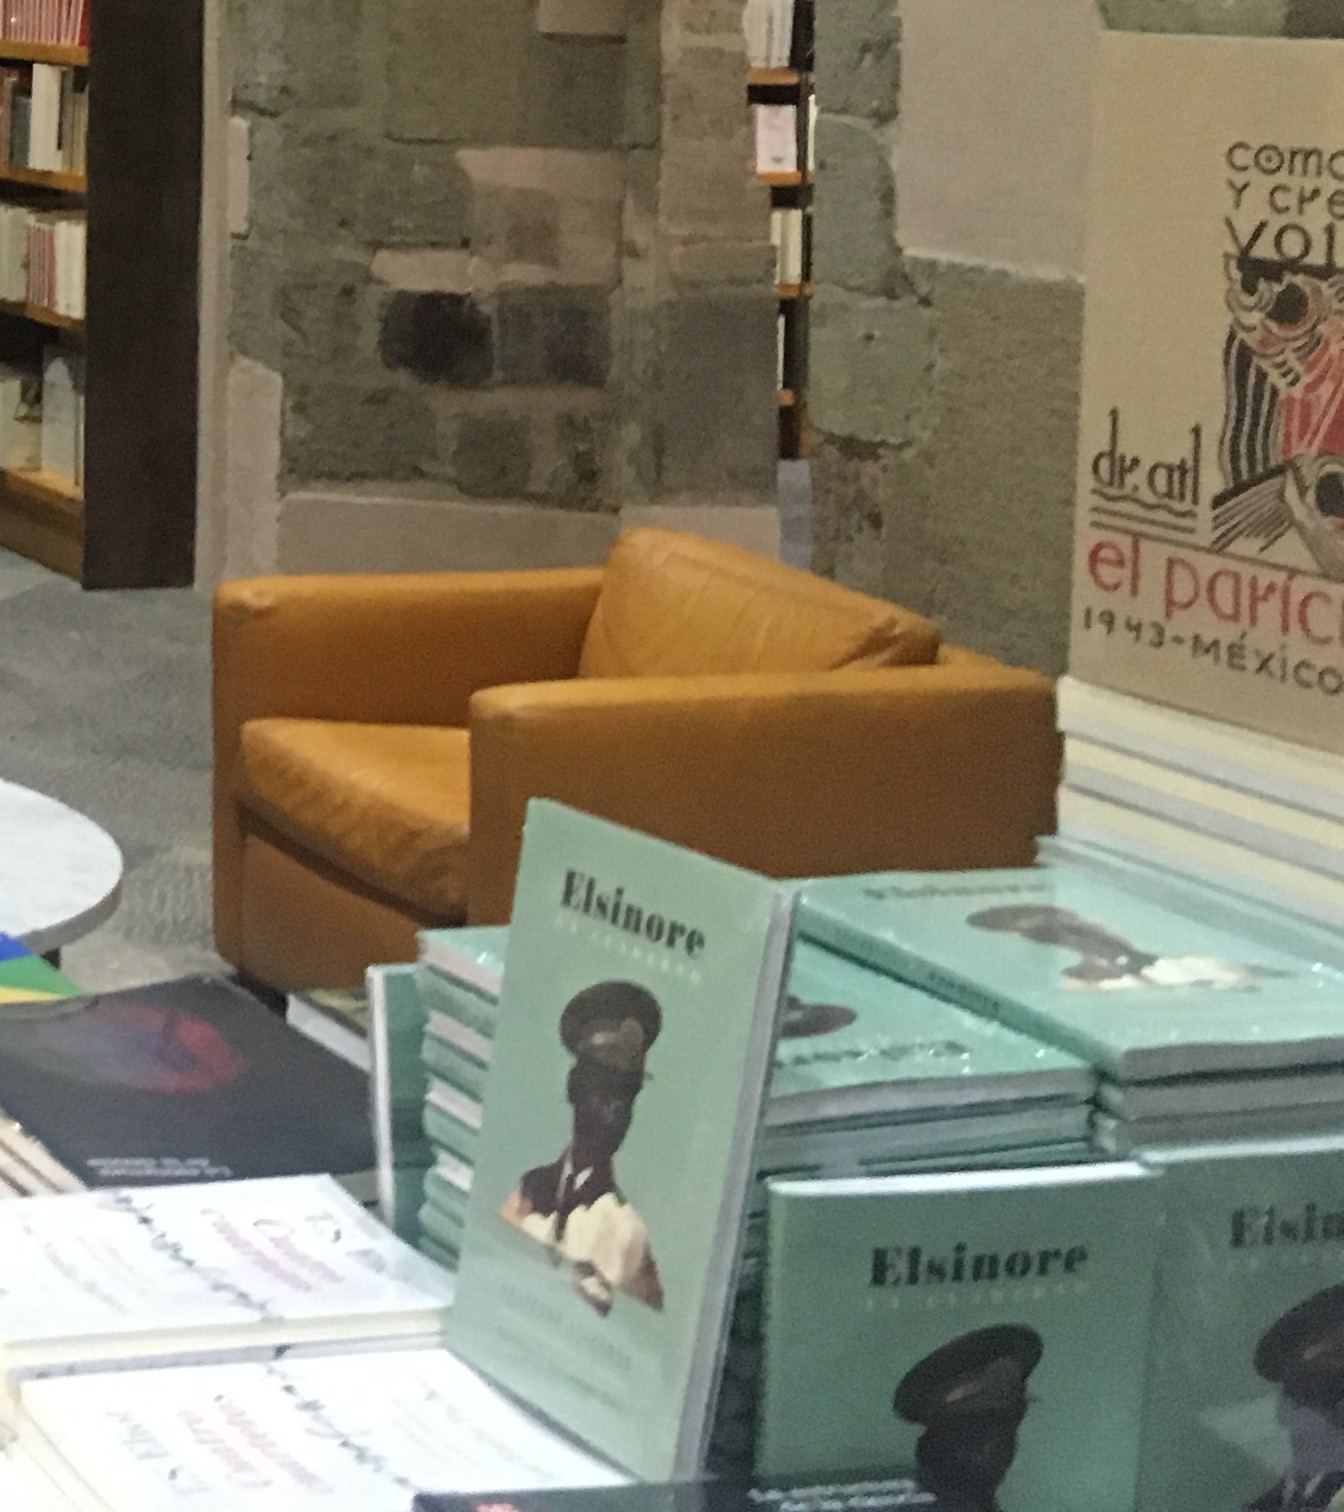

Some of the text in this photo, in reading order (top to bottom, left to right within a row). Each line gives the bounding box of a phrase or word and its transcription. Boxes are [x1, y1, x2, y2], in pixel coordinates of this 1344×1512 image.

[1088, 536, 1344, 648] el paríc
[560, 869, 706, 959] Elsinore
[869, 1241, 1089, 1288] Elsinore
